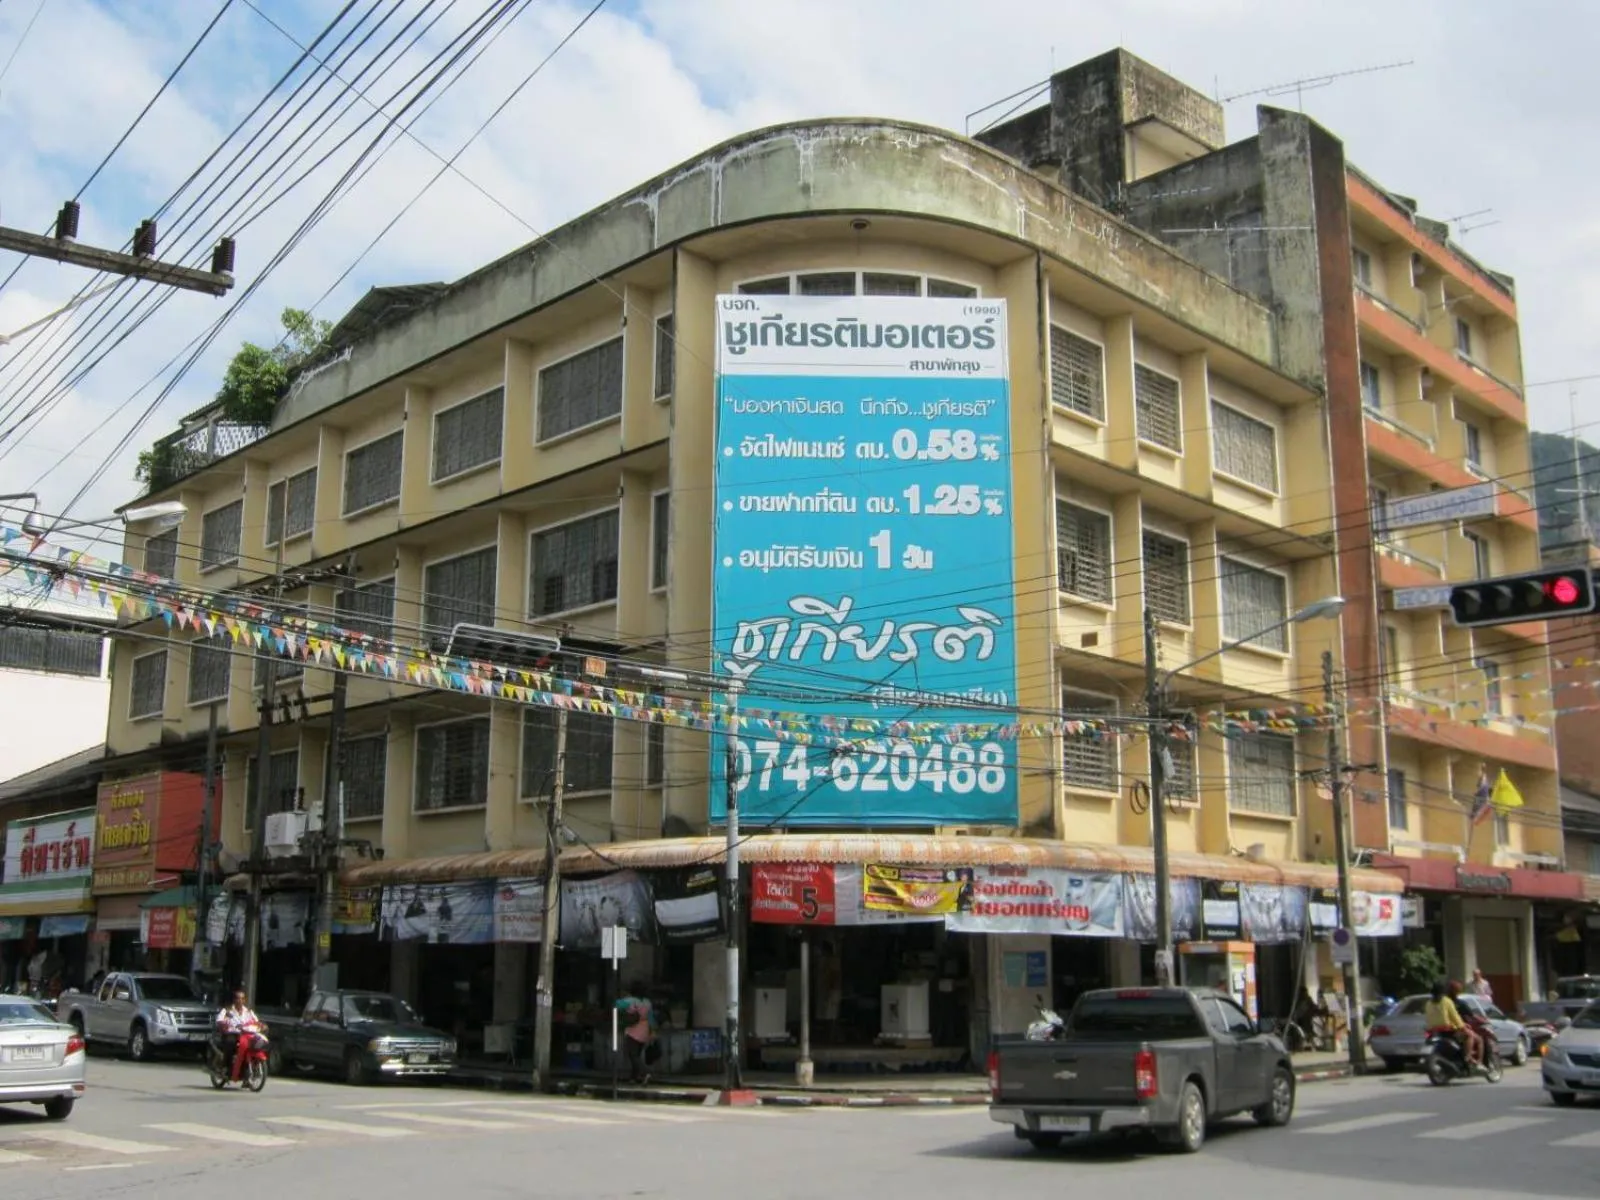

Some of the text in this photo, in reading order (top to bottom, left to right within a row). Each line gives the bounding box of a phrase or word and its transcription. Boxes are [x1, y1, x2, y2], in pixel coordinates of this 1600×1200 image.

[722, 298, 761, 312] บจก.
[724, 313, 997, 356] ชูเกียรติมอเตอร์
[909, 358, 981, 376] สาขาพัทลุง
[739, 432, 847, 460] จัดไฟแนนซ์
[739, 487, 857, 514] ขายฝากที่ดิน
[739, 529, 934, 574] อนุมัติรับเงิน 1 วัน
[722, 595, 1004, 678] ชูเกียรติ
[724, 740, 1007, 795] 074-620488
